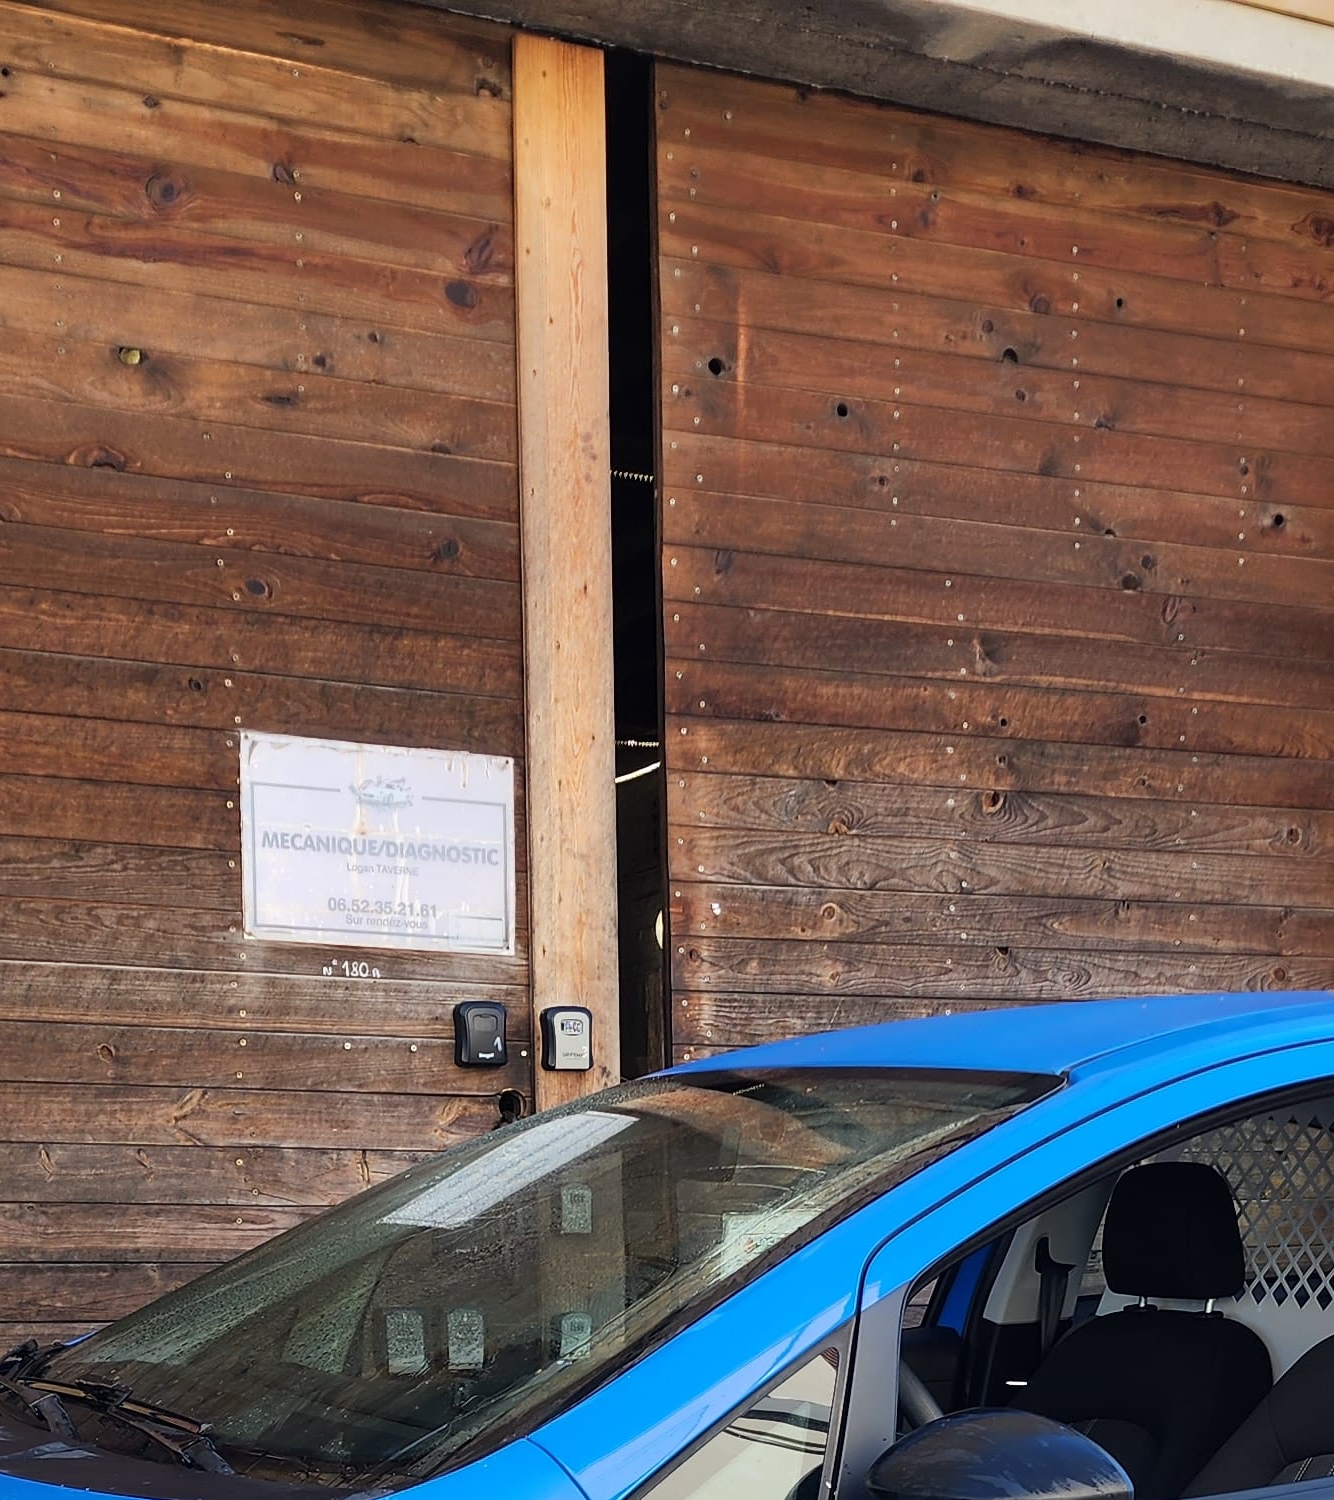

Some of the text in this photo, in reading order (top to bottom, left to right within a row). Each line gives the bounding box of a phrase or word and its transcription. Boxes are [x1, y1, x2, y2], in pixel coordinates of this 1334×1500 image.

[261, 831, 500, 866] MECANIQUE/DIAGNOSTIC
[346, 862, 374, 875] Logan
[328, 897, 438, 918] 06.52.35.21.61
[346, 914, 363, 926] Sur
[342, 960, 369, 978] 180
